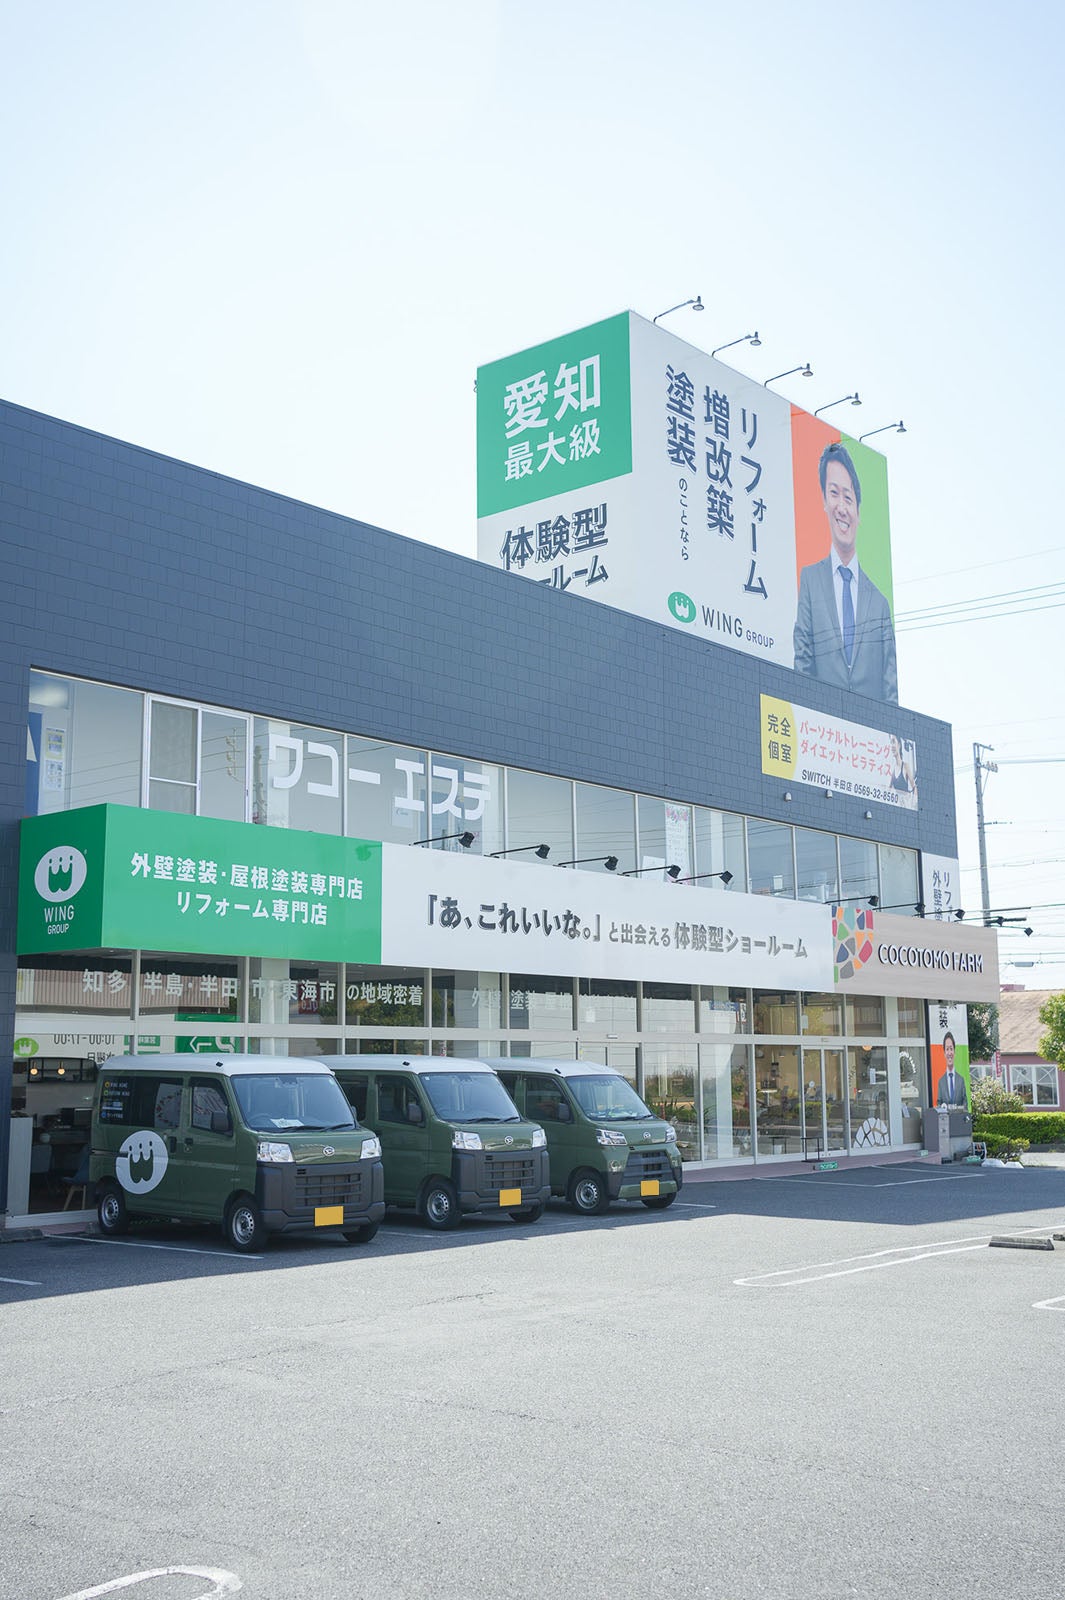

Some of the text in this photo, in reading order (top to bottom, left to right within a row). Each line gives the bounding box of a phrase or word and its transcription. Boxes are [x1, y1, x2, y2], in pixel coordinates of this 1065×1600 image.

[503, 353, 601, 440] 愛知
[503, 418, 601, 482] 最大級
[703, 385, 735, 541] 増改築
[741, 407, 768, 600] リフォーム
[499, 502, 609, 571] 体験型
[702, 605, 775, 649] WING GROUP
[767, 713, 791, 738] 完全
[800, 720, 891, 759] パーソナルトレーニング
[768, 739, 792, 764] 個室
[268, 733, 491, 821] ワコー エステ
[801, 769, 832, 787] SWITCH
[853, 784, 899, 804] 0569-32-8560
[130, 852, 363, 900] 外壁塗装・屋根塗装専門店
[44, 904, 75, 923] WING
[176, 890, 328, 926] リフォーム専門店
[47, 923, 70, 935] GROUP
[878, 943, 984, 974] COCOTOMO FARM
